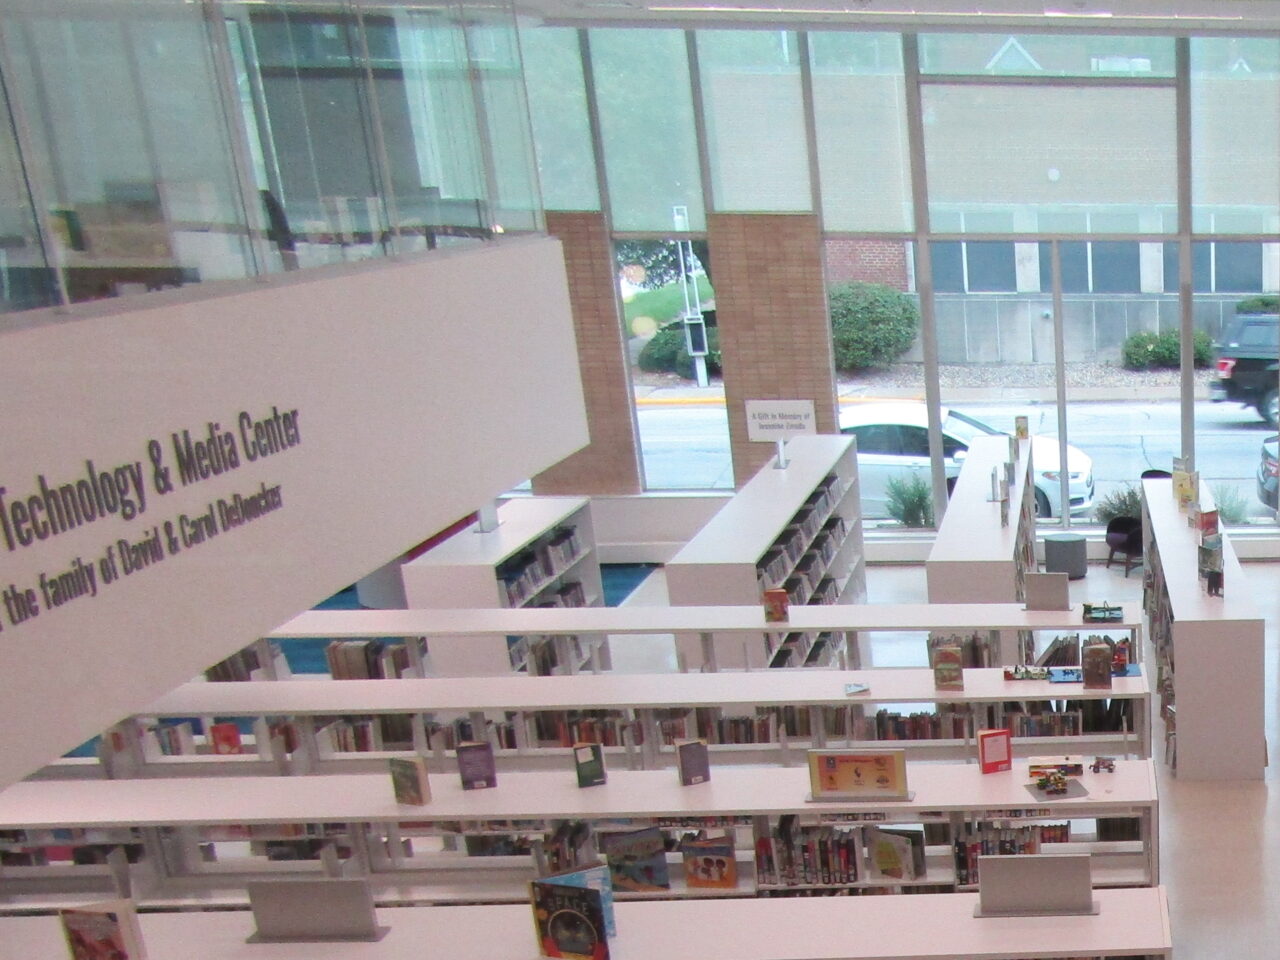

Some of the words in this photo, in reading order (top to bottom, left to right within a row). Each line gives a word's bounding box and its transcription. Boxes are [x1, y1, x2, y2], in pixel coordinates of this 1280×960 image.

[757, 412, 769, 420] Gift
[778, 412, 802, 421] Memory
[0, 459, 146, 551] Technology
[148, 439, 174, 495] &
[172, 422, 240, 486] Media
[239, 406, 300, 462] Center
[3, 584, 39, 625] the
[38, 557, 96, 610] family
[99, 546, 119, 584] of
[117, 526, 164, 575] David
[163, 521, 181, 556] &
[179, 503, 219, 549] Carol
